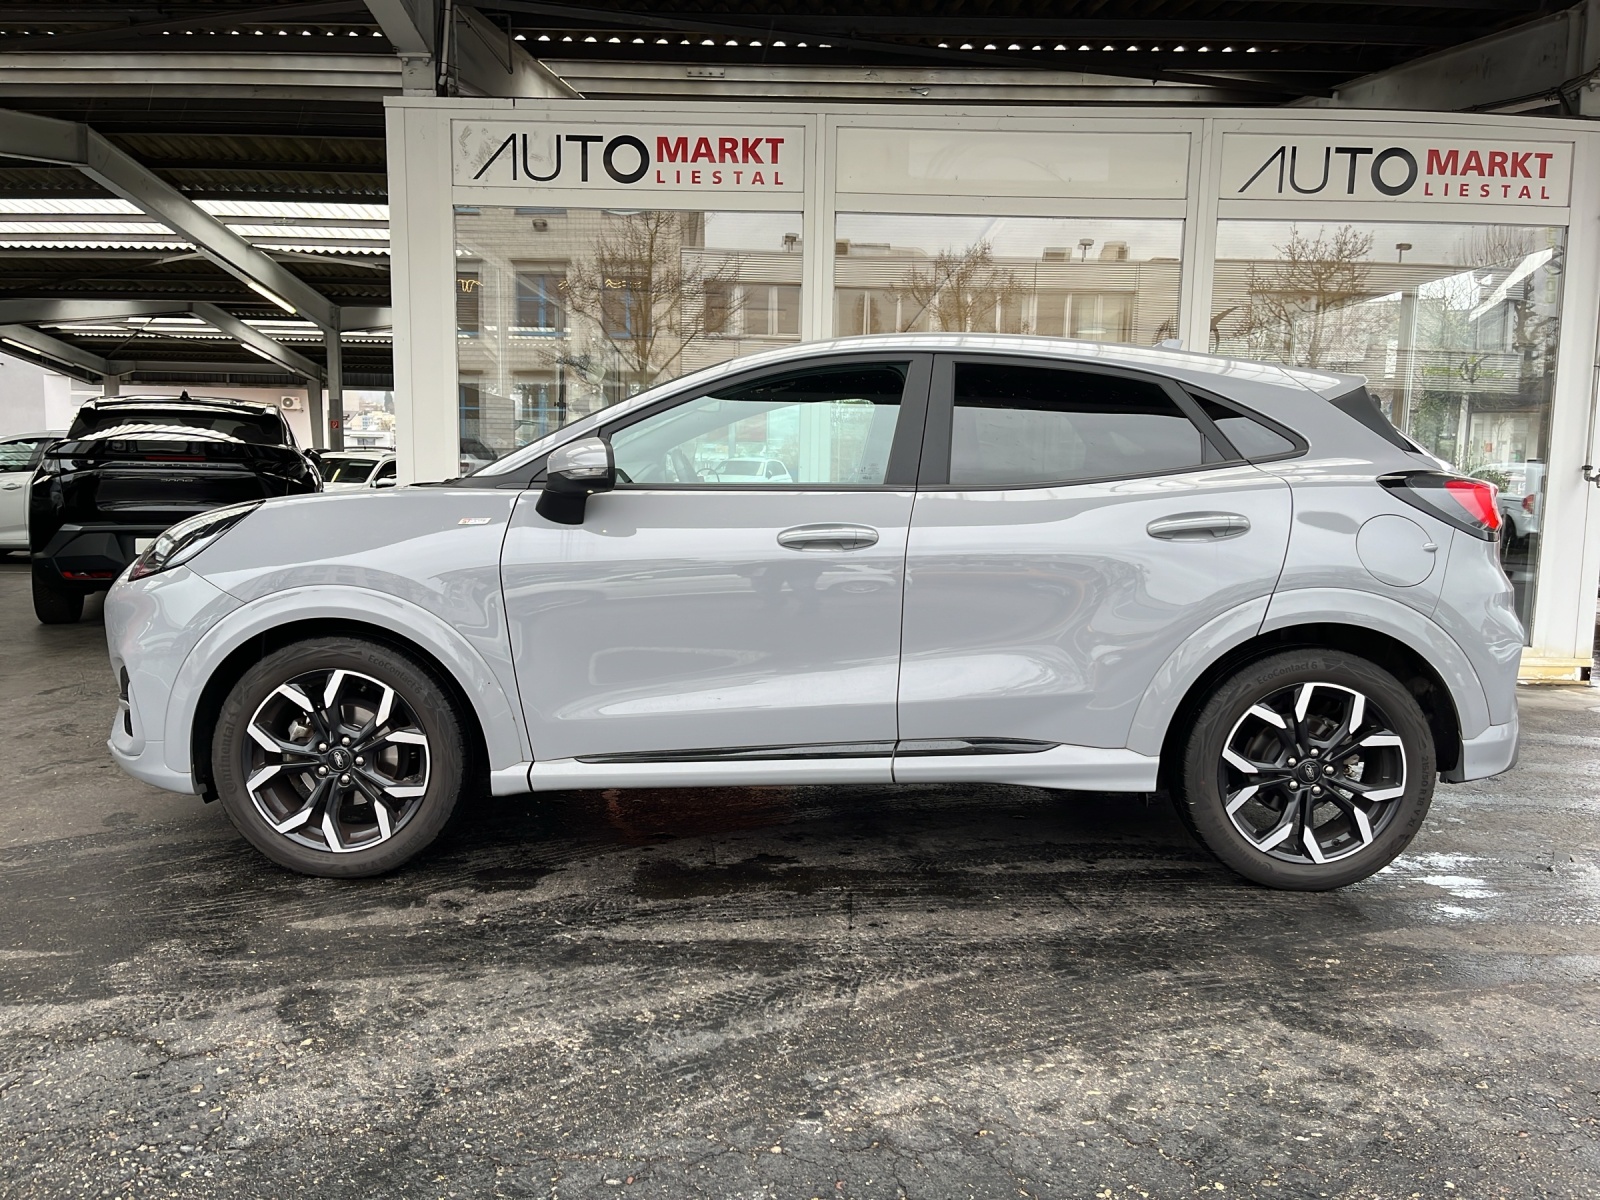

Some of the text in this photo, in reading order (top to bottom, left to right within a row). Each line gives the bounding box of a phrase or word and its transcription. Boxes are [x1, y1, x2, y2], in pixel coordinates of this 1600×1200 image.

[472, 133, 785, 184] AUTO MARKT
[1237, 145, 1553, 196] AUTO MARKT
[656, 170, 784, 185] LIESTAL
[1424, 182, 1550, 200] LIESTAL
[368, 654, 423, 694] EcoContact 6
[1257, 661, 1318, 685] EcoContact 6
[219, 720, 239, 796] Continental
[1420, 755, 1429, 787] 215/50
